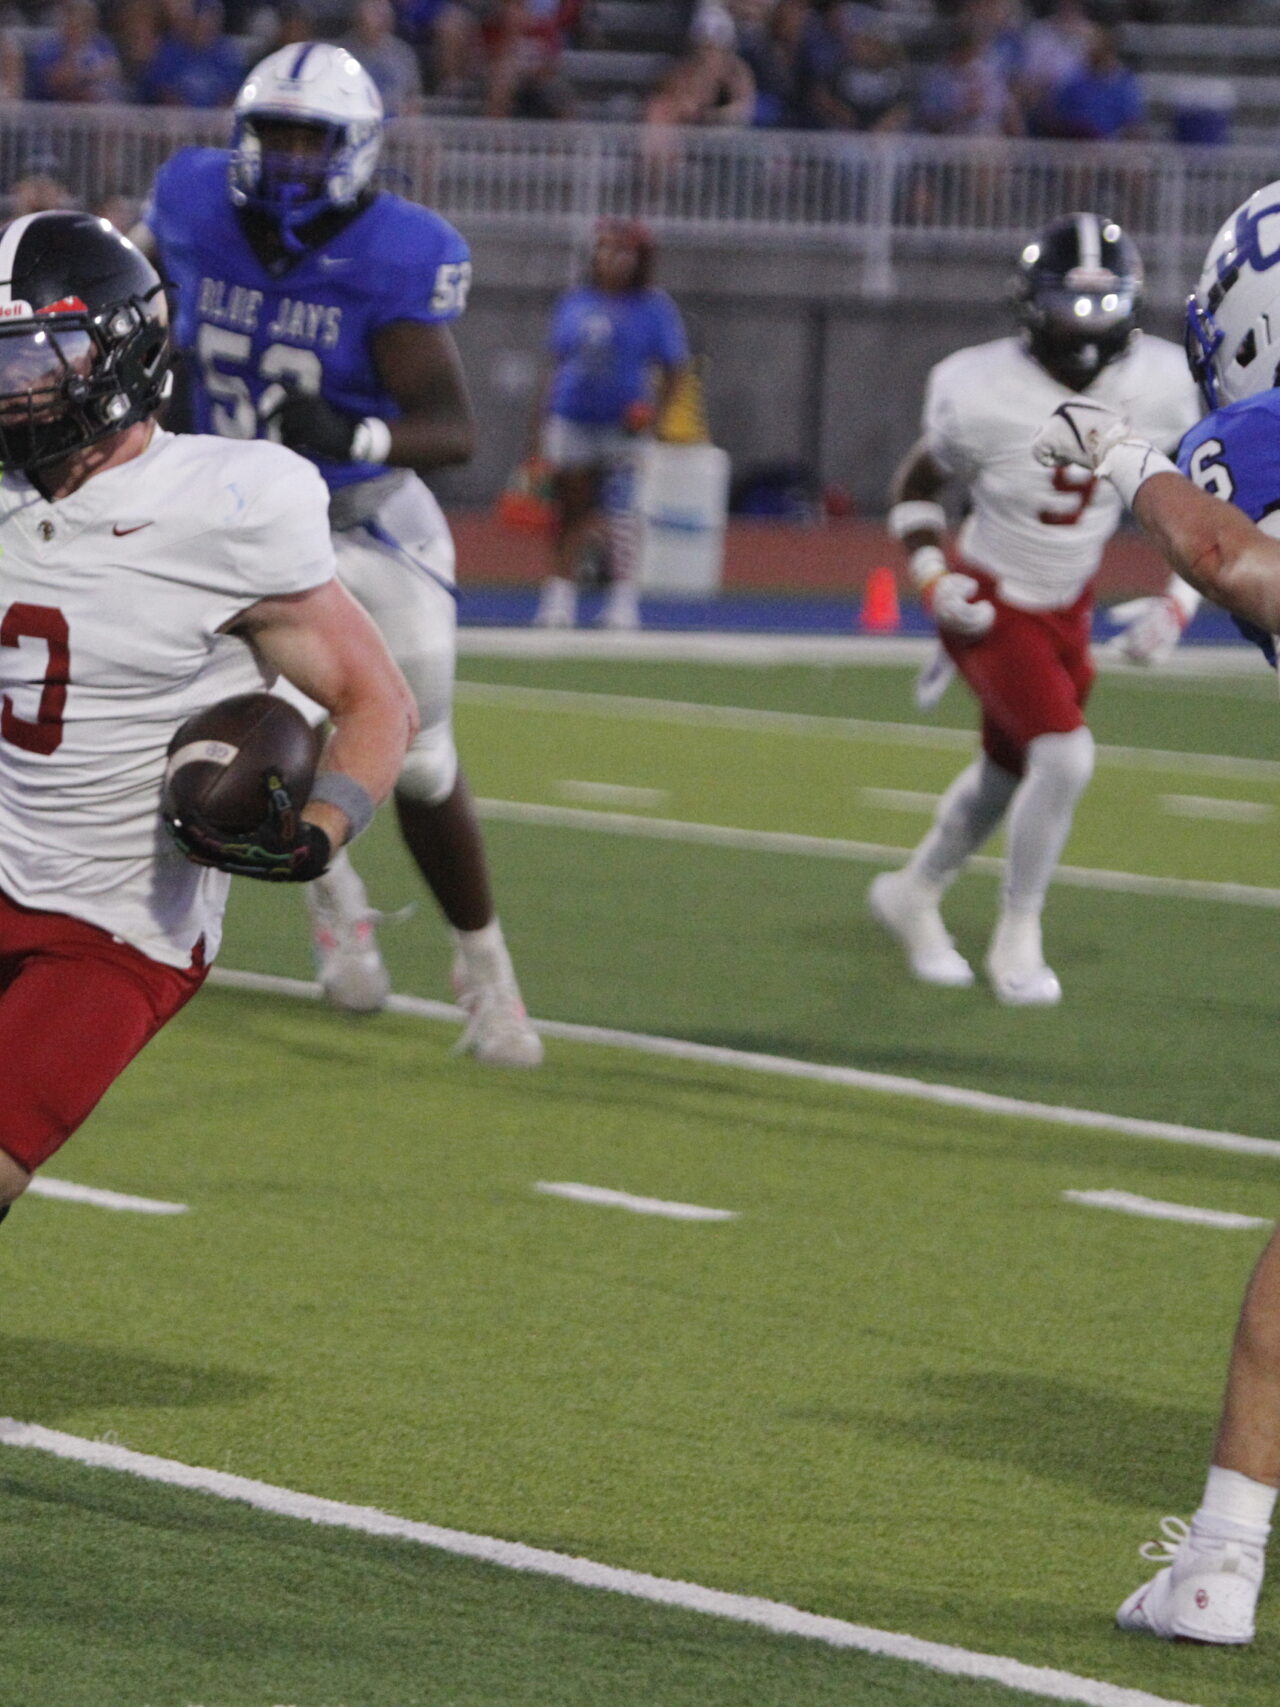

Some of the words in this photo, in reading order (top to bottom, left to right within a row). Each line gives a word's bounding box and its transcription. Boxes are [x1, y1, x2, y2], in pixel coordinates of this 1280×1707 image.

[198, 276, 263, 330] BLUE
[269, 297, 342, 348] JAYS
[1189, 437, 1237, 502] 6
[0, 601, 70, 756] 3
